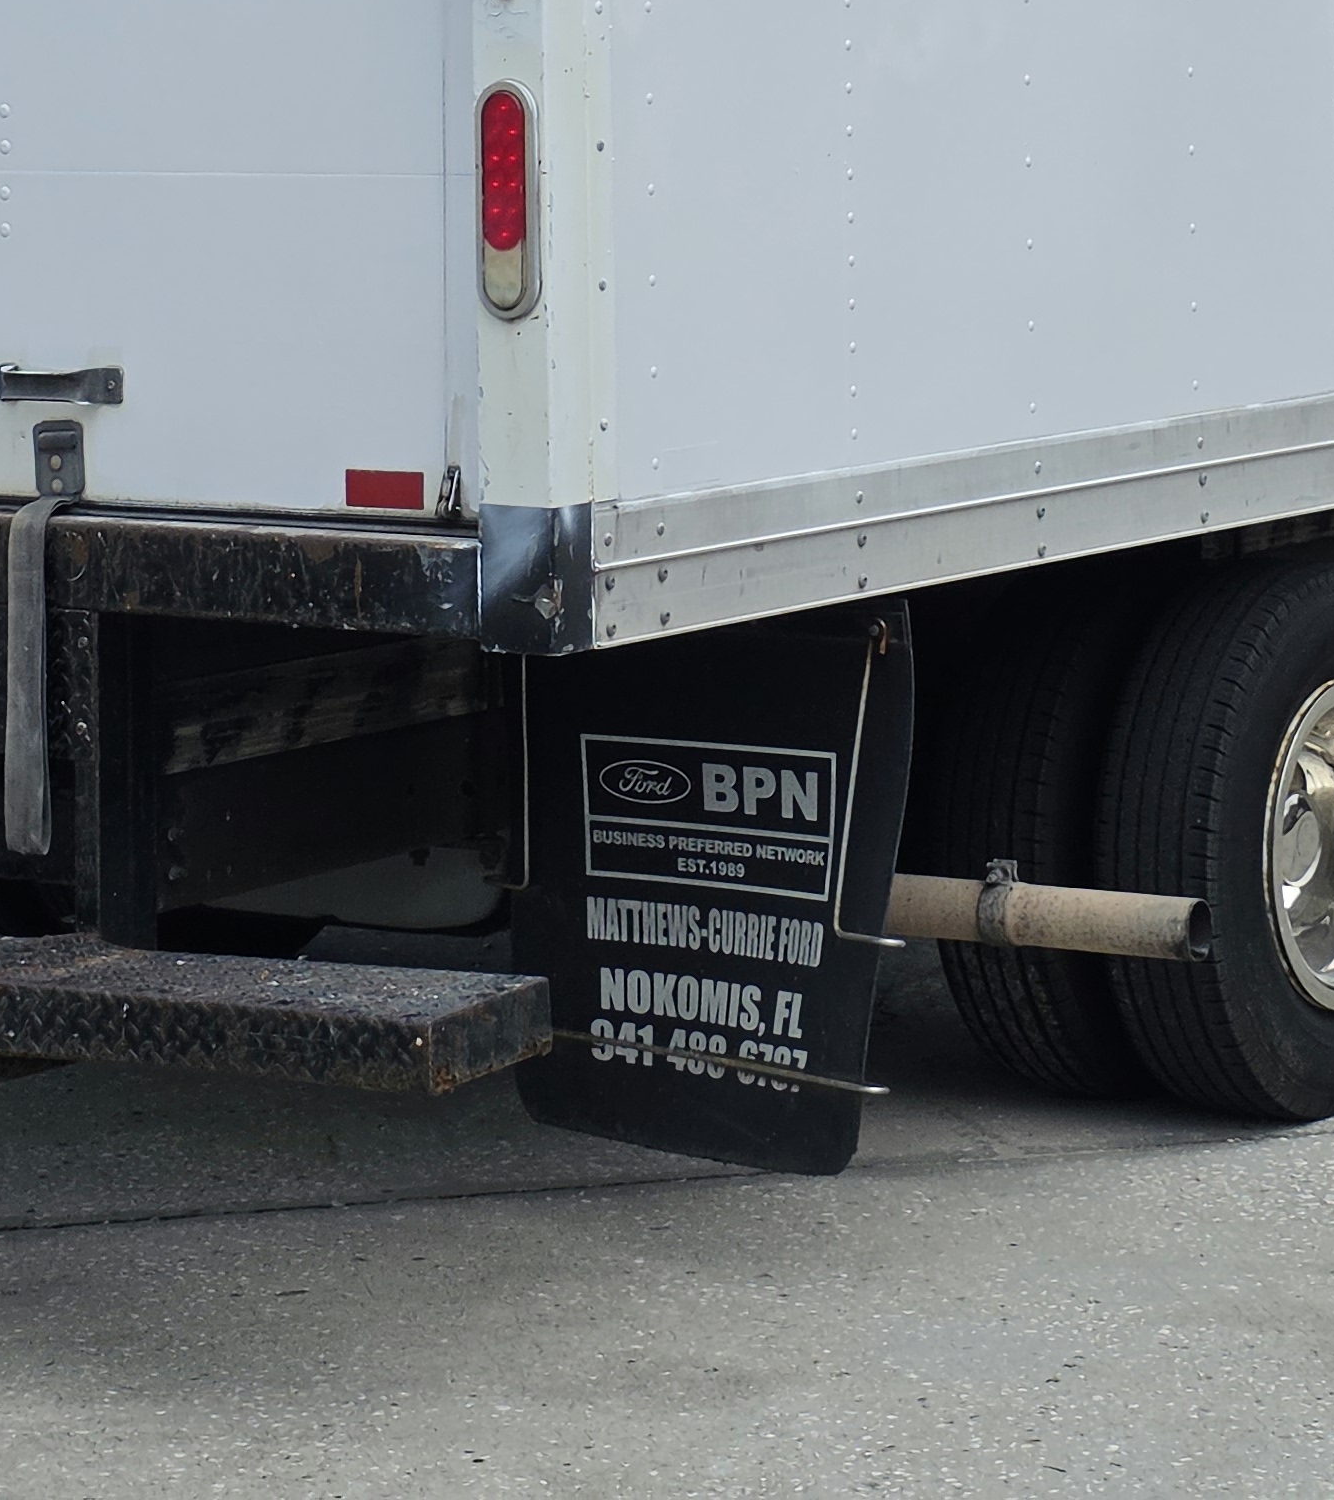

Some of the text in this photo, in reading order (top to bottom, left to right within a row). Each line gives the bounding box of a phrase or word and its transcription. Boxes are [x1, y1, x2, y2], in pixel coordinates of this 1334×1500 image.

[618, 762, 819, 821] Ford BPN
[592, 829, 825, 866] BUSINESS PREFERRED NETWORK
[677, 857, 746, 878] EST.1989
[586, 896, 824, 968] MATTHEWS-CURRIE FORD
[599, 967, 803, 1039] NOKOMIS, FL
[590, 1018, 654, 1066] 941
